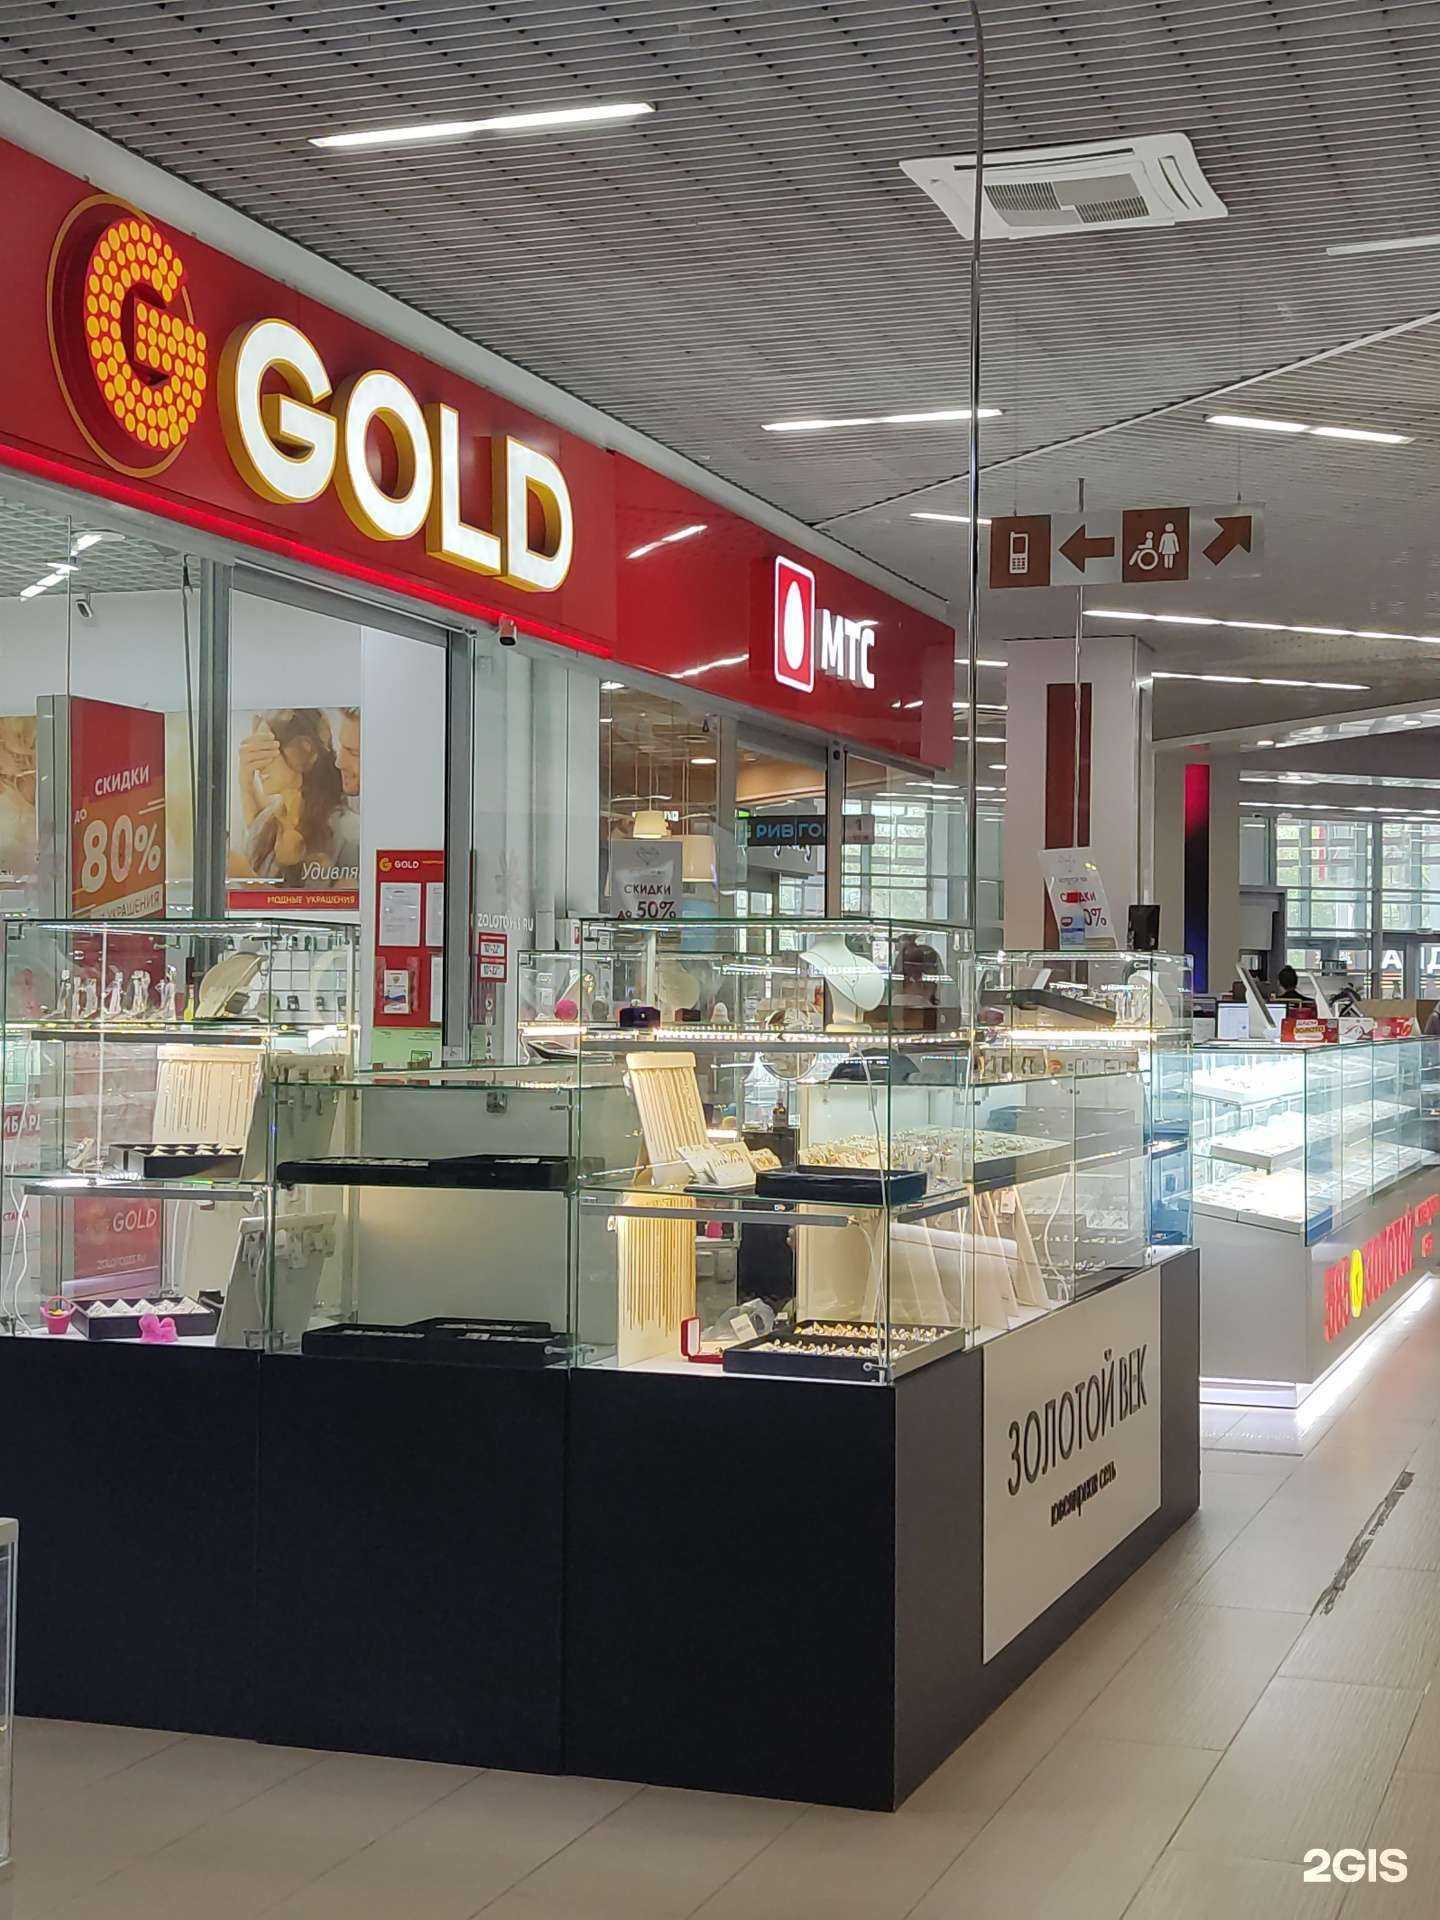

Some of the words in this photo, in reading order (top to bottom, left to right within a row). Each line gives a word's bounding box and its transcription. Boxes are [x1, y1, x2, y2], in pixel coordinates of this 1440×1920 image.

[219, 318, 574, 592] GOLD
[818, 609, 875, 689] МТС
[95, 765, 150, 796] СКИДКИ
[82, 815, 161, 892] 80%
[394, 859, 420, 870] GOLD
[624, 884, 671, 896] СКИДКИ
[636, 900, 677, 919] 50%
[113, 1208, 158, 1233] GOLD
[1007, 1348, 1115, 1496] ЗОЛОТОЙ
[1119, 1343, 1148, 1422] ВЕК
